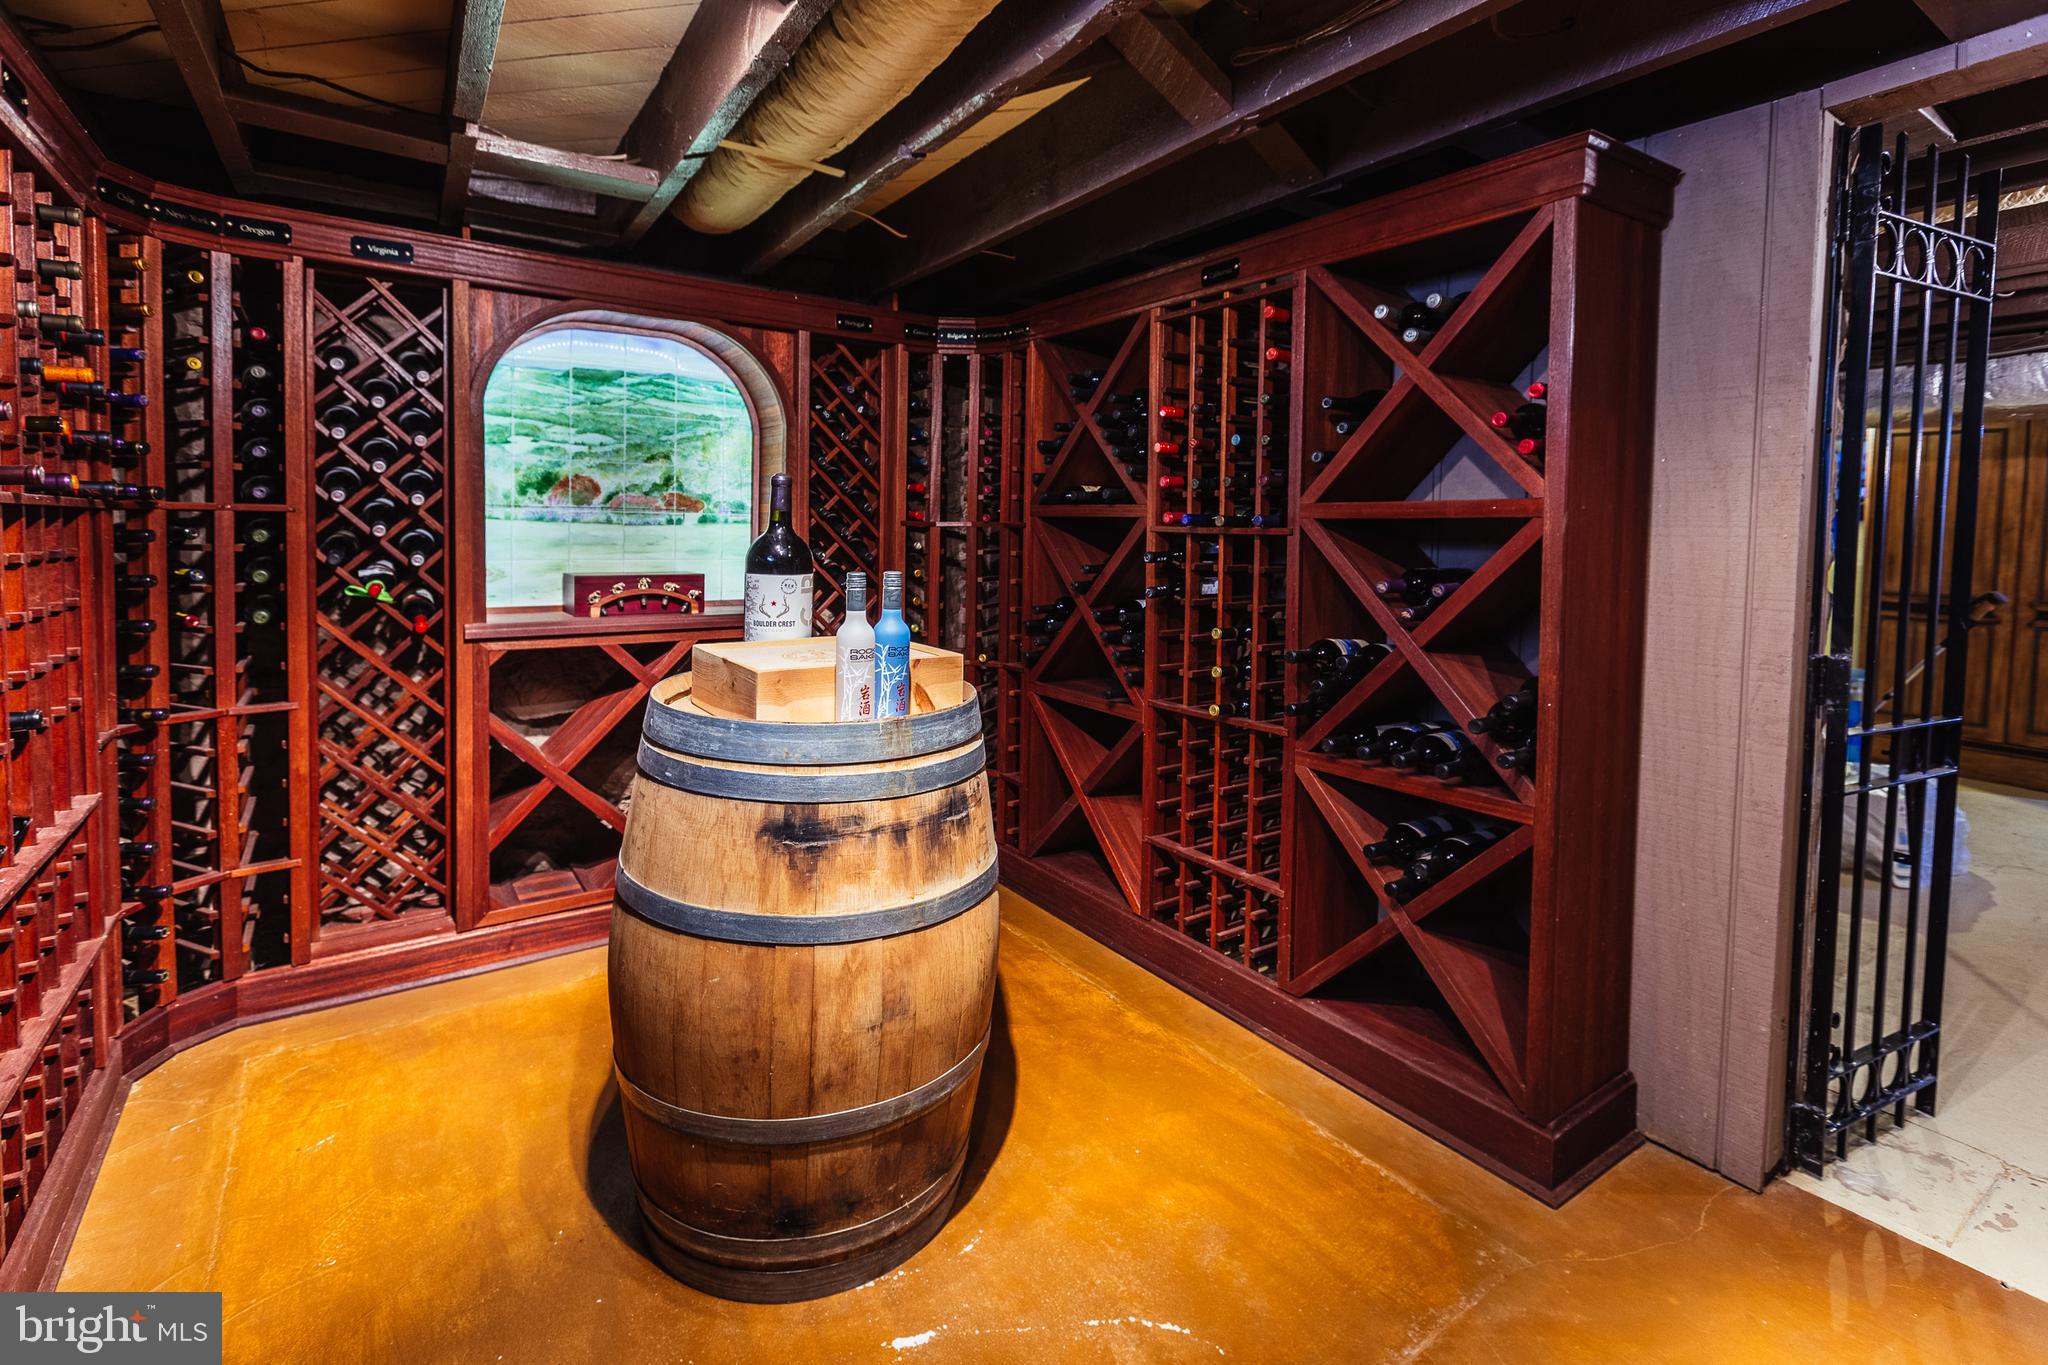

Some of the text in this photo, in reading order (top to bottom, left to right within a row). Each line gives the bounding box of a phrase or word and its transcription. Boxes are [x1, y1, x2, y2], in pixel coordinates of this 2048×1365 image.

[239, 223, 276, 238] Oregon
[367, 244, 399, 256] Virginia
[946, 332, 967, 340] Bulgaria
[753, 619, 796, 628] BOULDER CREST
